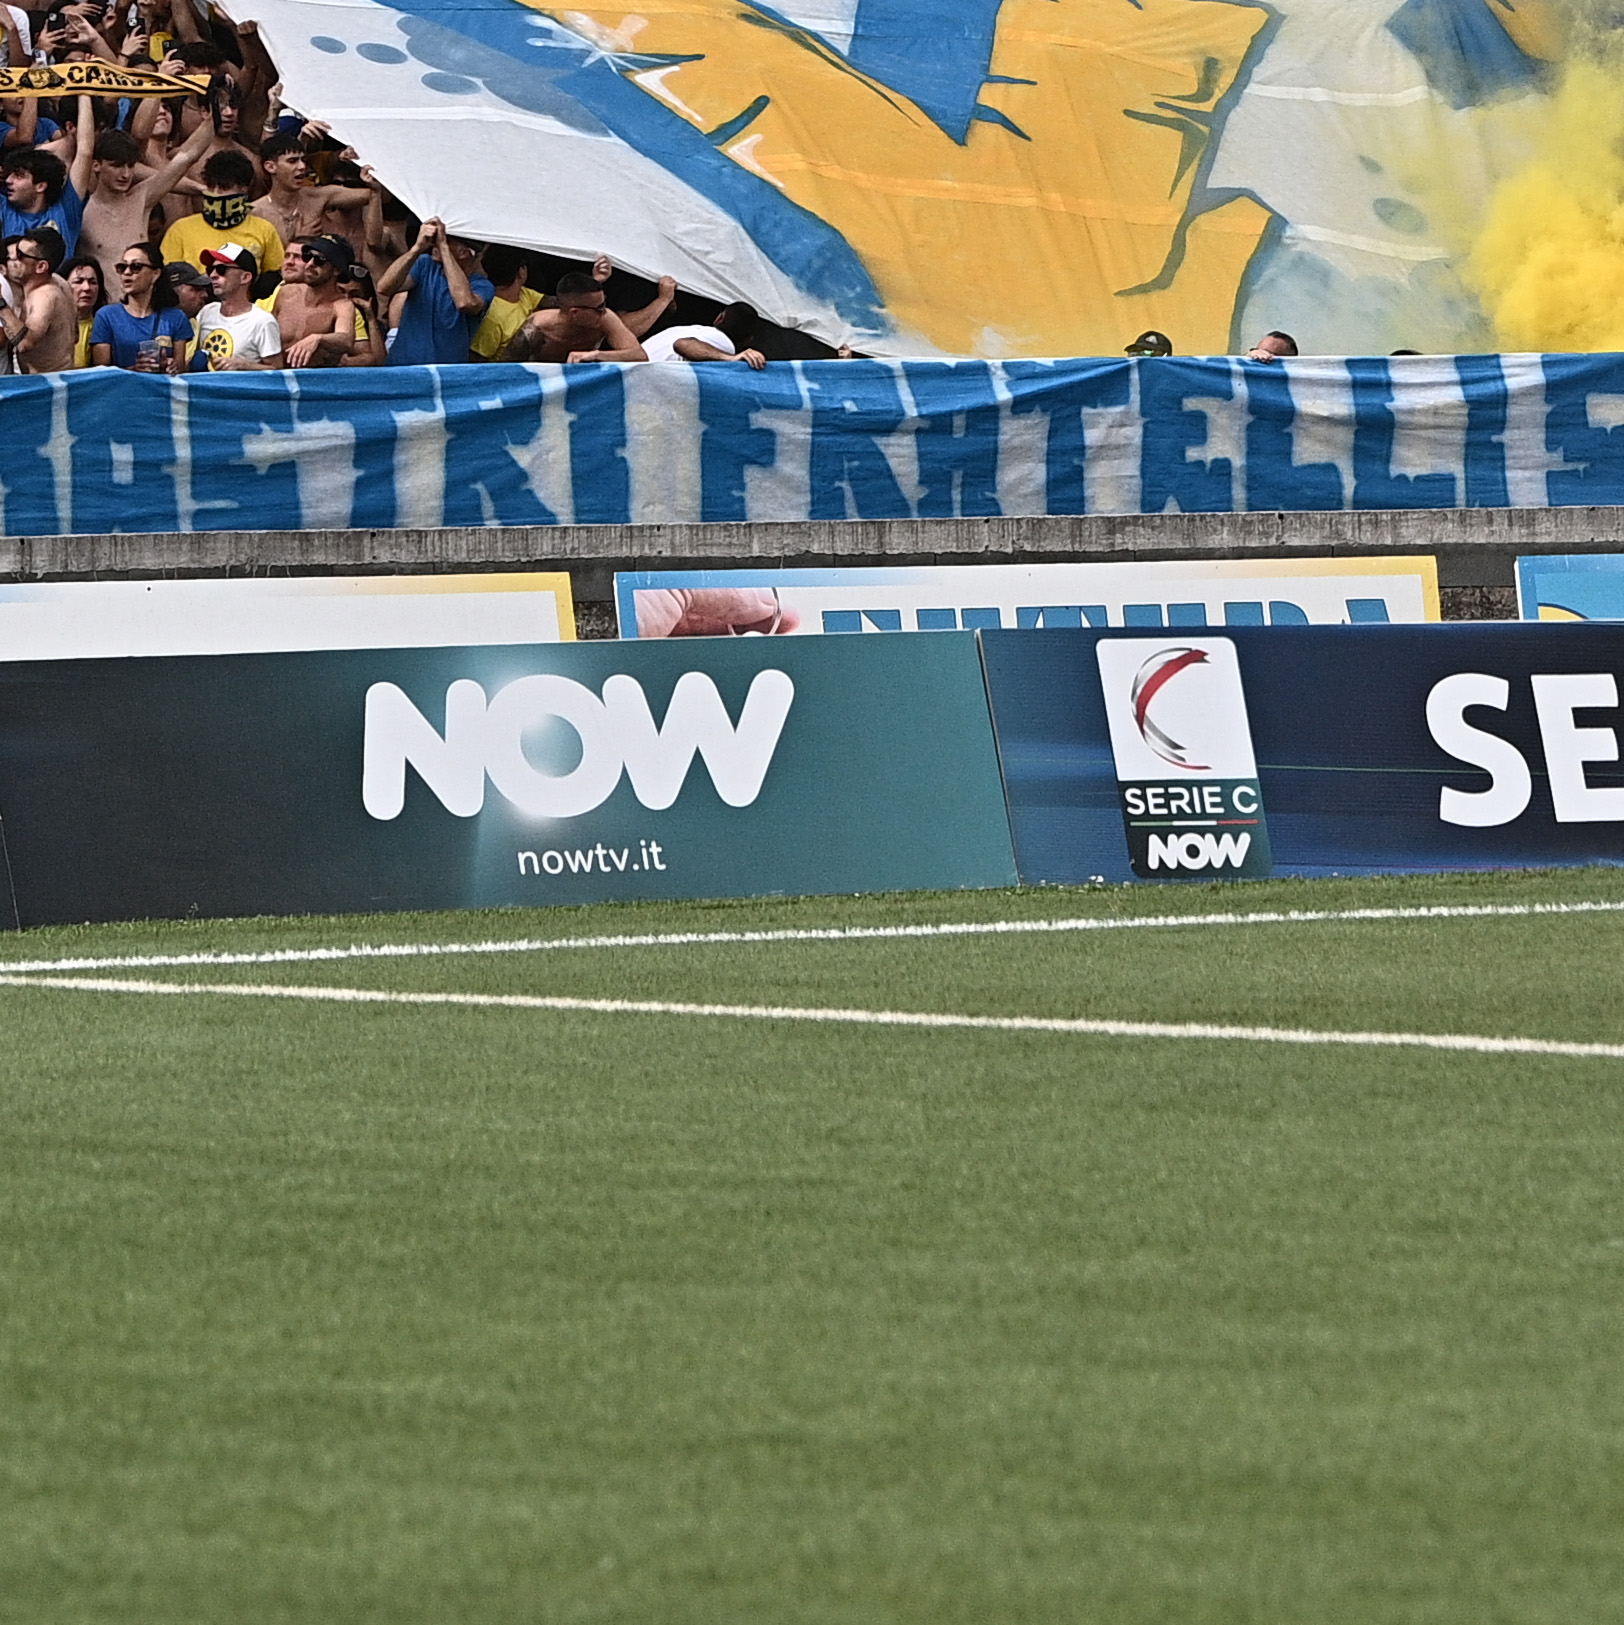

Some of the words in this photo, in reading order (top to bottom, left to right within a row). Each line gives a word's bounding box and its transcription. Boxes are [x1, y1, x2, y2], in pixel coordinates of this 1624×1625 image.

[697, 356, 1506, 524] FRATELLI
[362, 668, 795, 821] NOW
[1124, 787, 1225, 816] SERIE
[1232, 786, 1259, 814] C
[517, 838, 667, 878] nowtv.it
[1147, 832, 1252, 871] NOW
